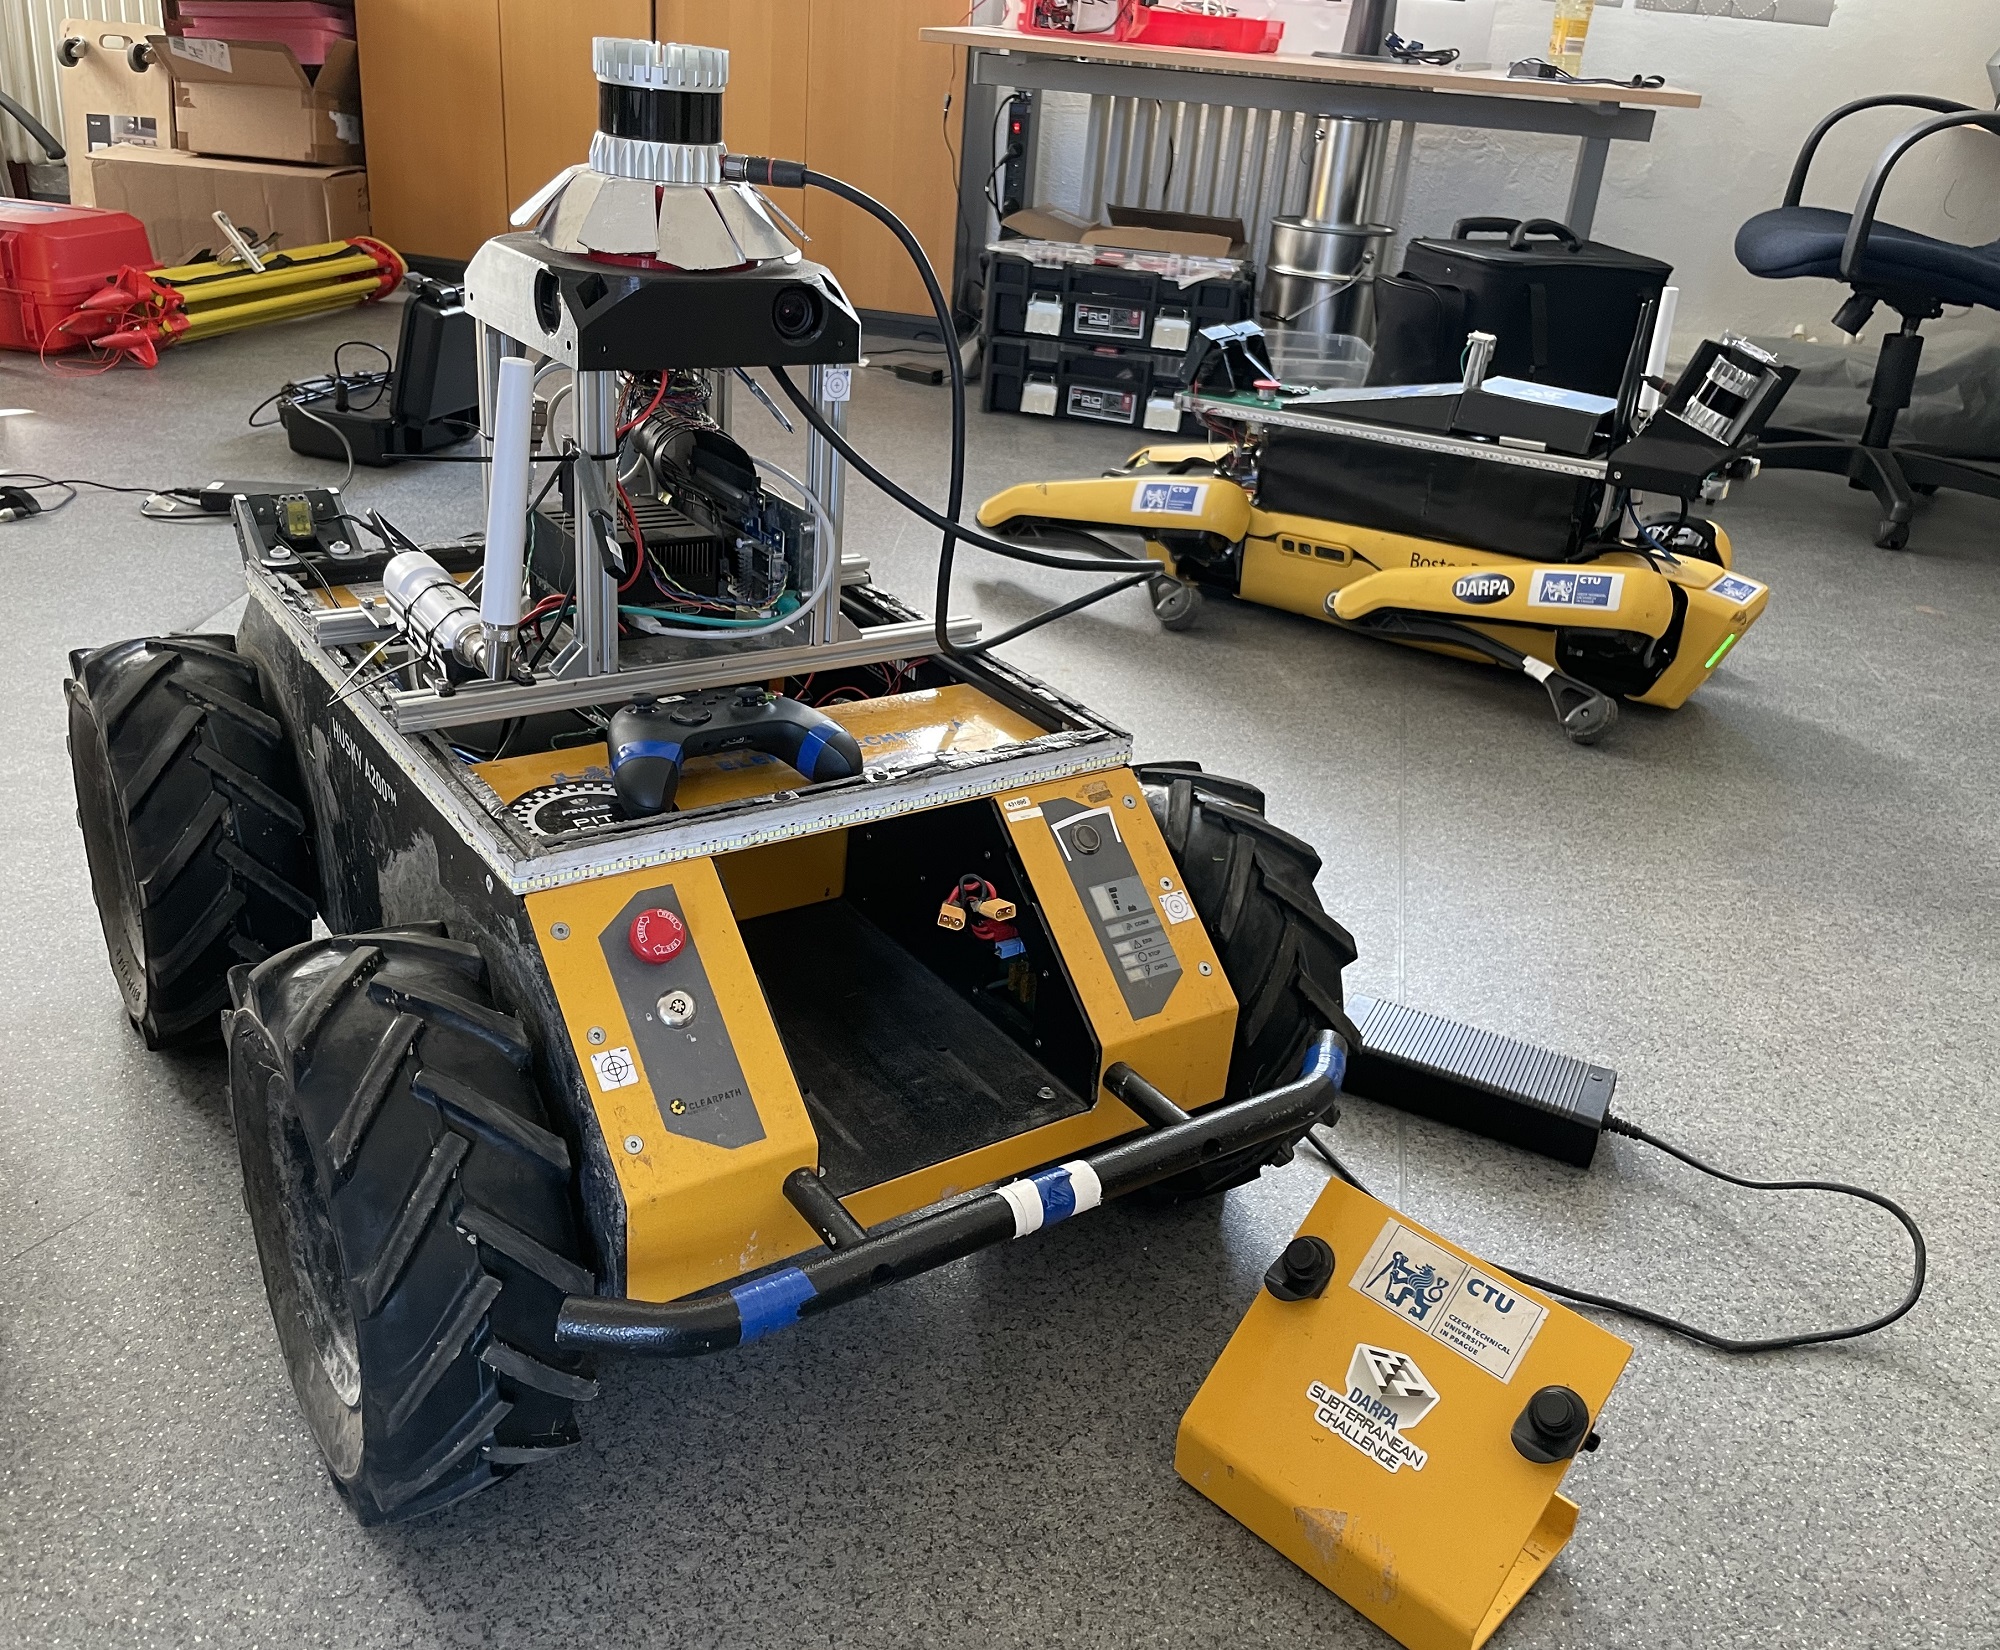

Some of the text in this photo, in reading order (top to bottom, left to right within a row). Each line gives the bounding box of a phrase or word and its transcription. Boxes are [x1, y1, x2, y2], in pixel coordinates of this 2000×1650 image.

[1078, 311, 1109, 321] PRO
[1071, 393, 1102, 405] PRO
[1172, 486, 1191, 494] CTU
[1455, 579, 1510, 597] DARPA
[1579, 576, 1601, 585] CTU
[332, 717, 362, 770] HUSKY
[572, 813, 613, 828] PIT
[689, 1088, 742, 1110] CLEARPATH
[1466, 1278, 1516, 1314] CTU
[1439, 1328, 1479, 1356] IN PRAGUE
[1444, 1321, 1487, 1350] UNIVERSITY
[1448, 1313, 1511, 1355] CZECH TECHNICAL
[1348, 1386, 1399, 1430] DARPA
[1309, 1384, 1424, 1467] SUBTERRANEAN
[1317, 1407, 1400, 1470] CHALLENGE
